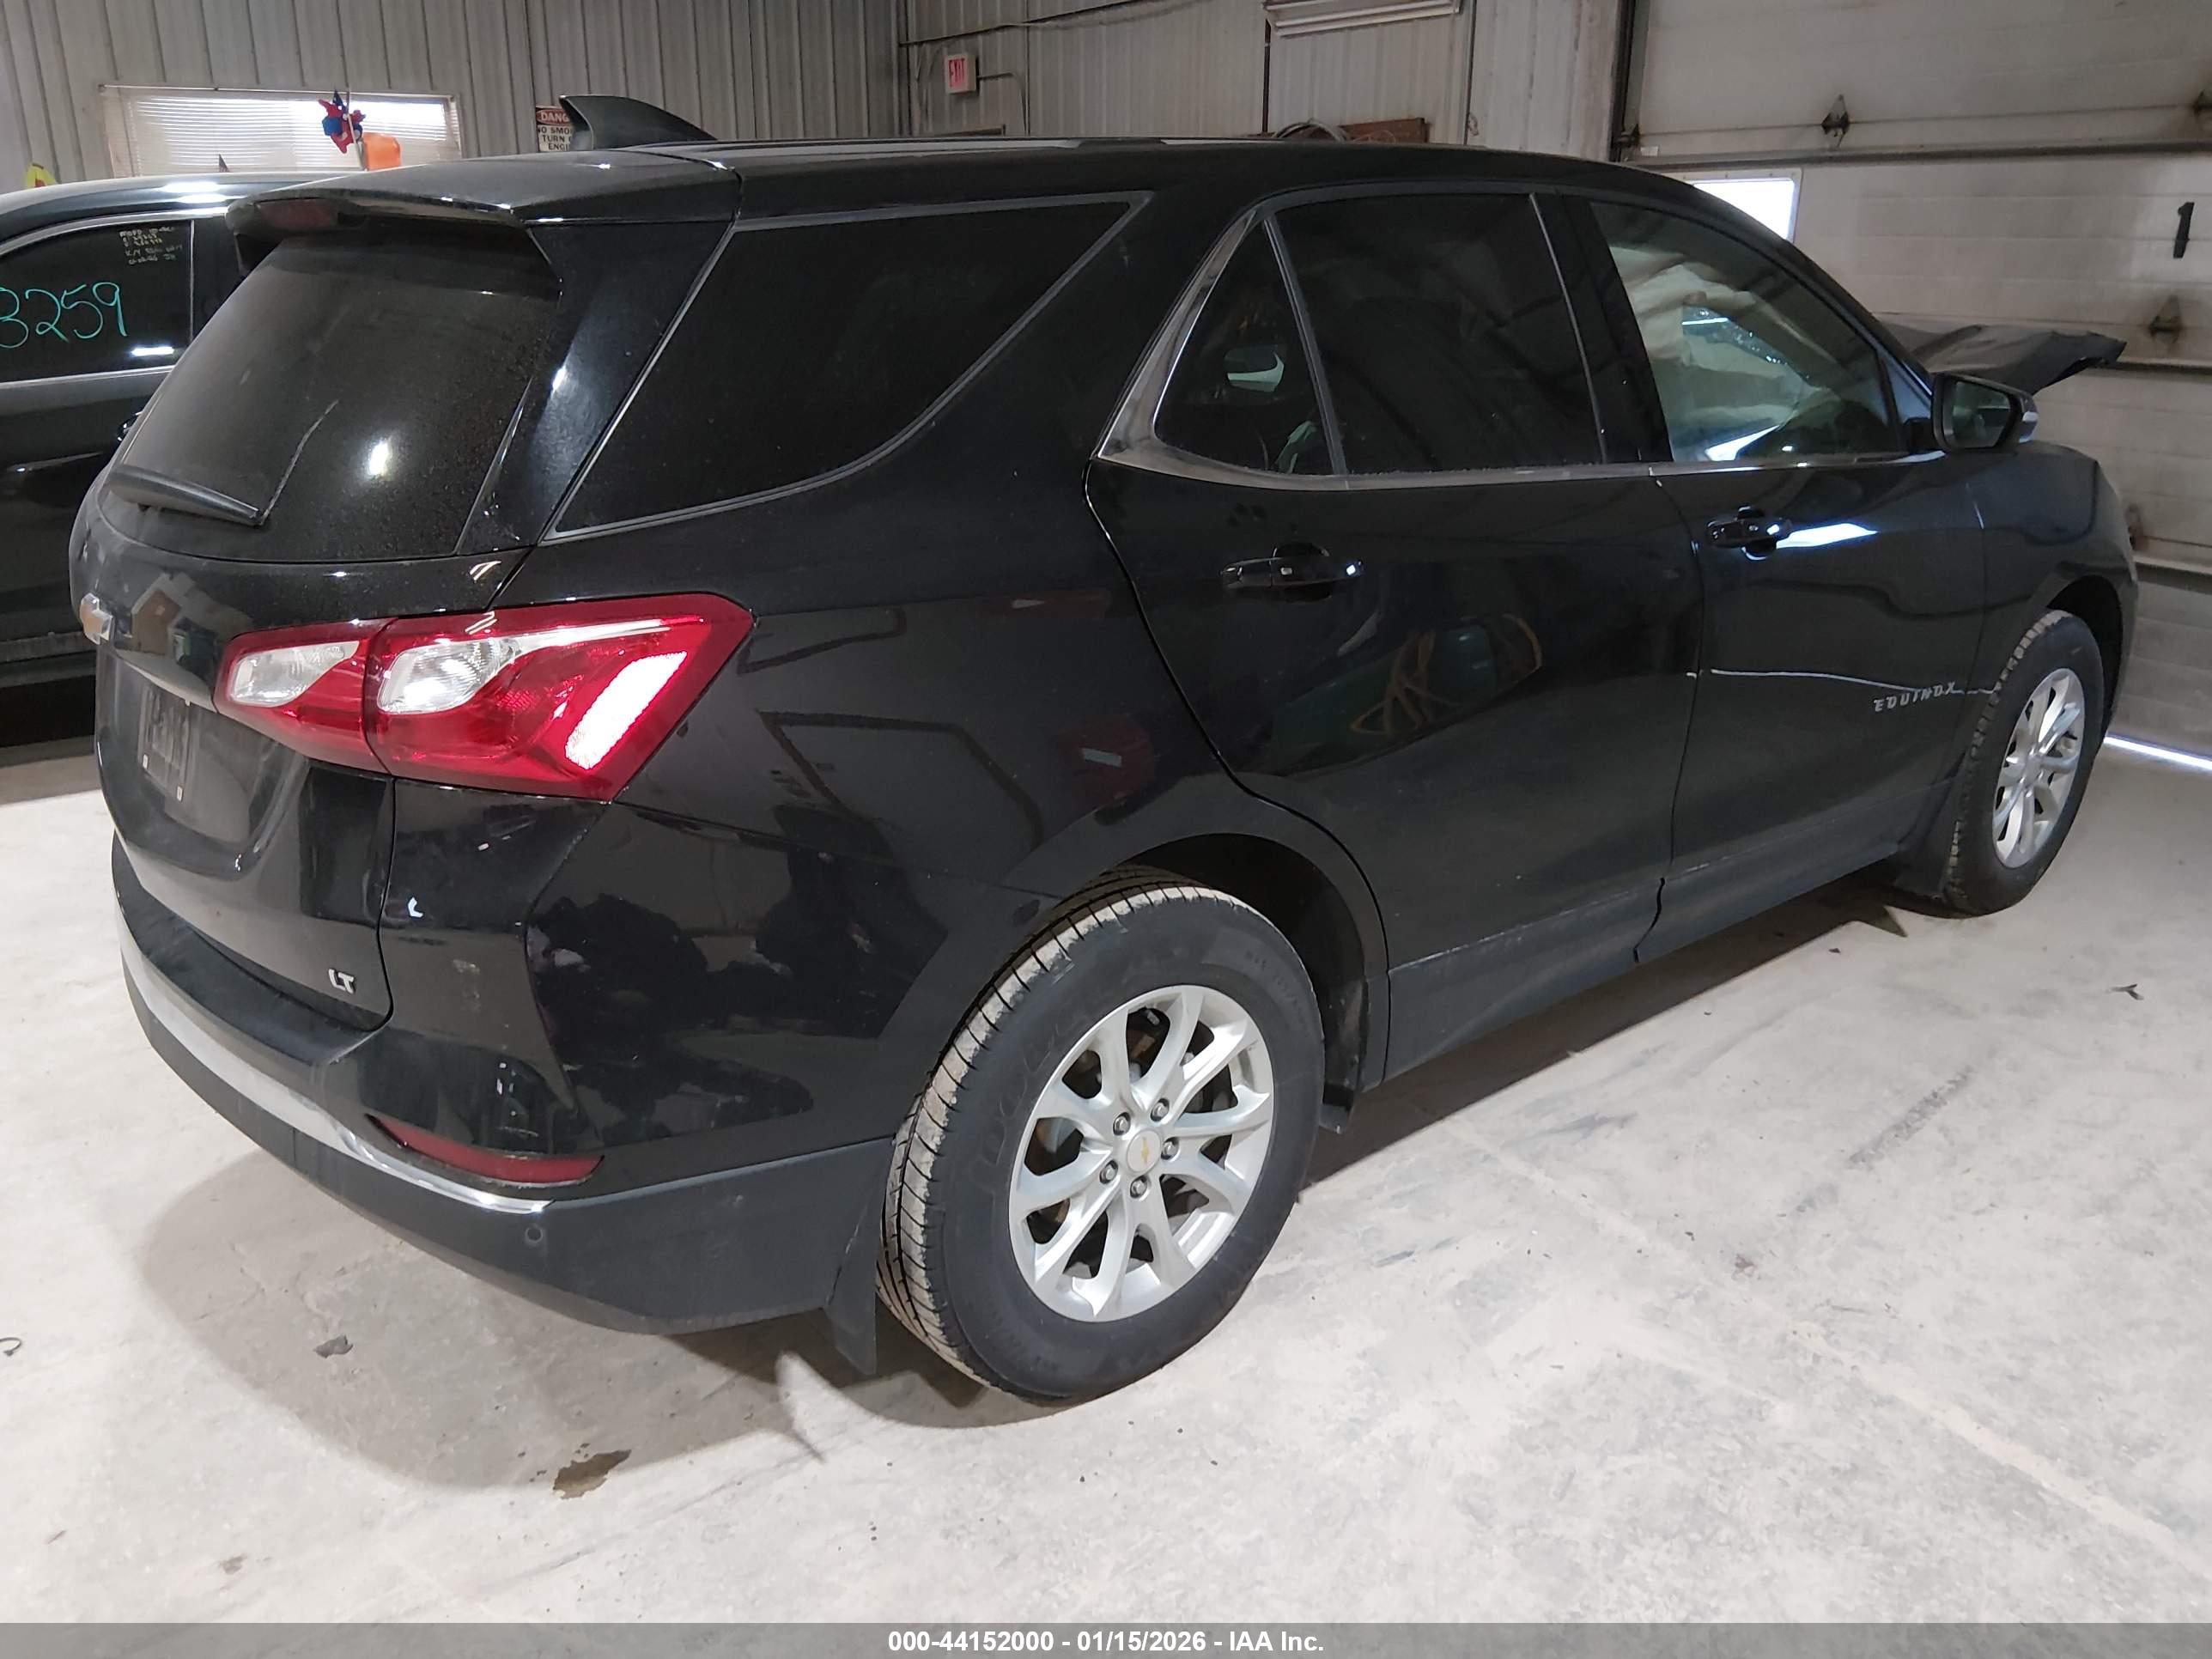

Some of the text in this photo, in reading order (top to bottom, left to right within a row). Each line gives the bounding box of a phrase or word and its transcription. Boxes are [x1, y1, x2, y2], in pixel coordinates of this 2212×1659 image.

[948, 58, 965, 88] EXIT
[2172, 201, 2196, 259] 1
[1874, 681, 1955, 712] EQUINOX
[328, 968, 355, 994] LT
